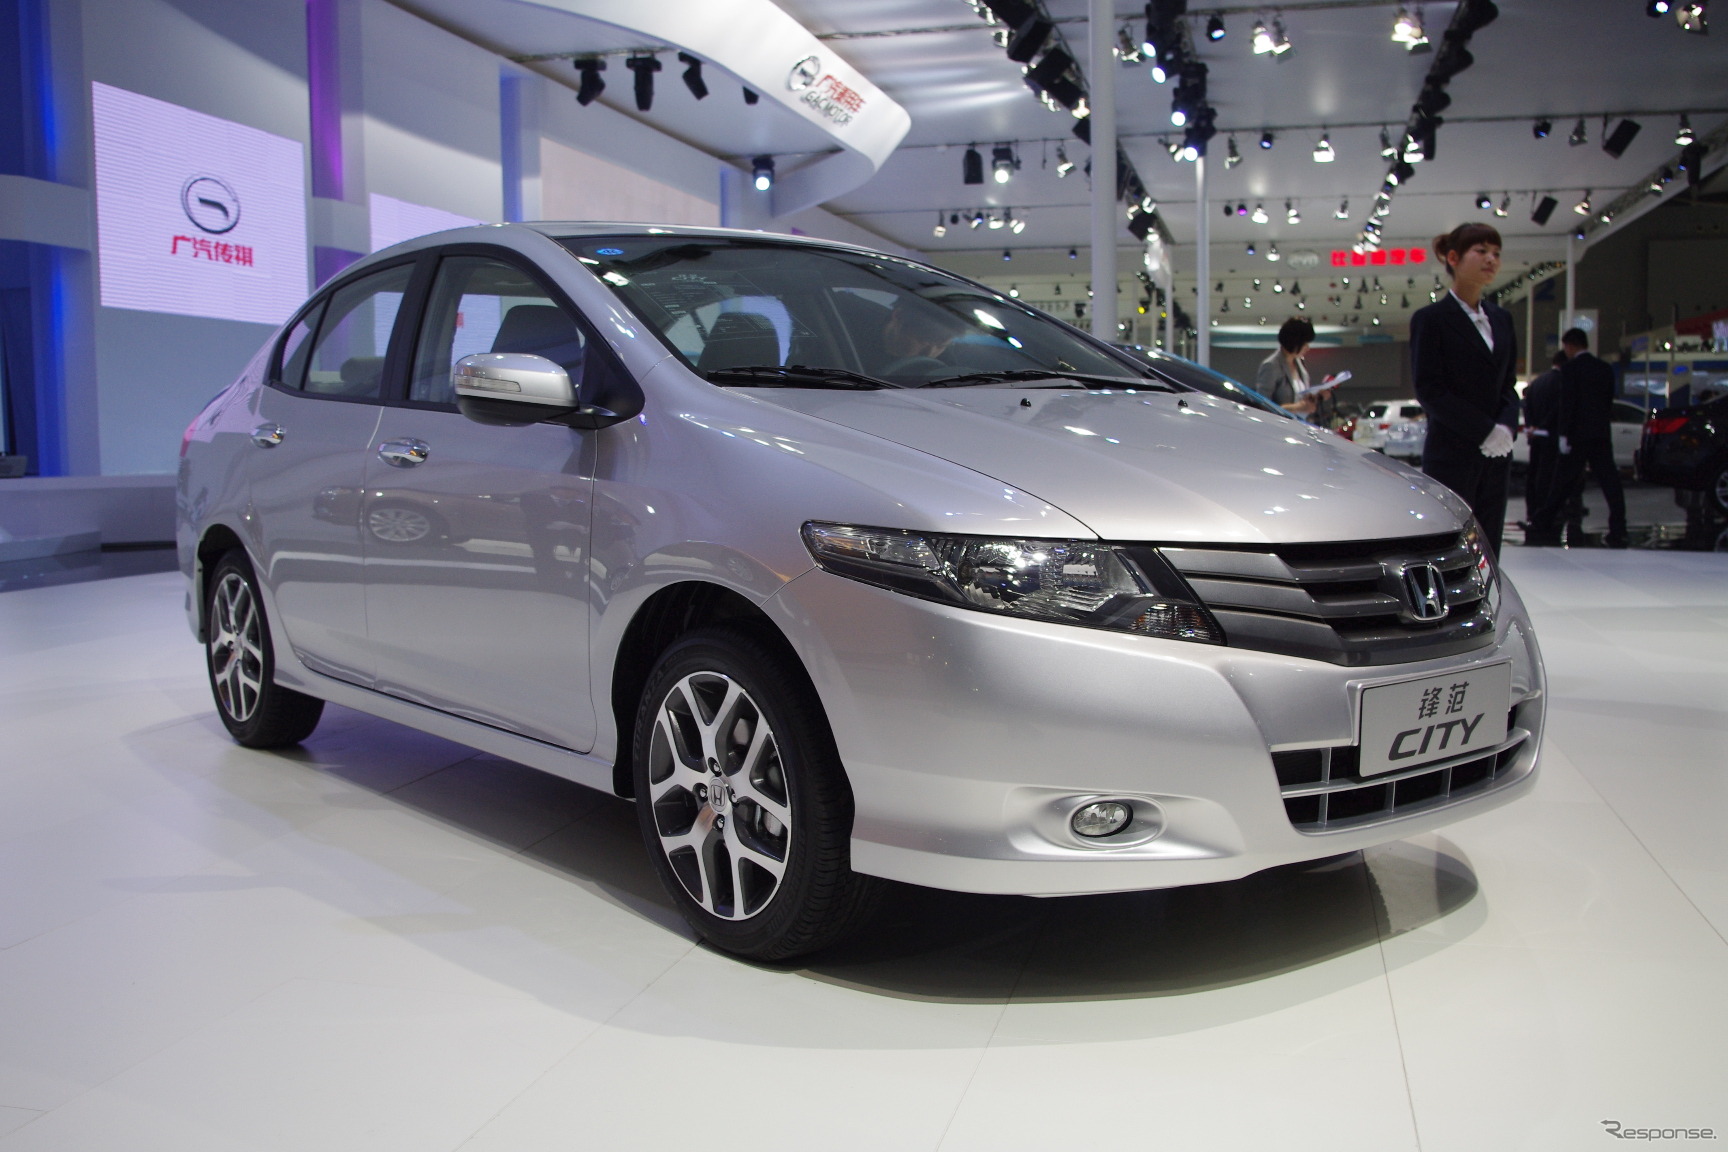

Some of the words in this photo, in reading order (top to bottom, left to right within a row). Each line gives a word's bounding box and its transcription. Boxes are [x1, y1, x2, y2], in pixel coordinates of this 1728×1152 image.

[171, 235, 253, 267] 广汽传祺
[1418, 681, 1469, 720] 锋范
[1388, 712, 1485, 761] CITY
